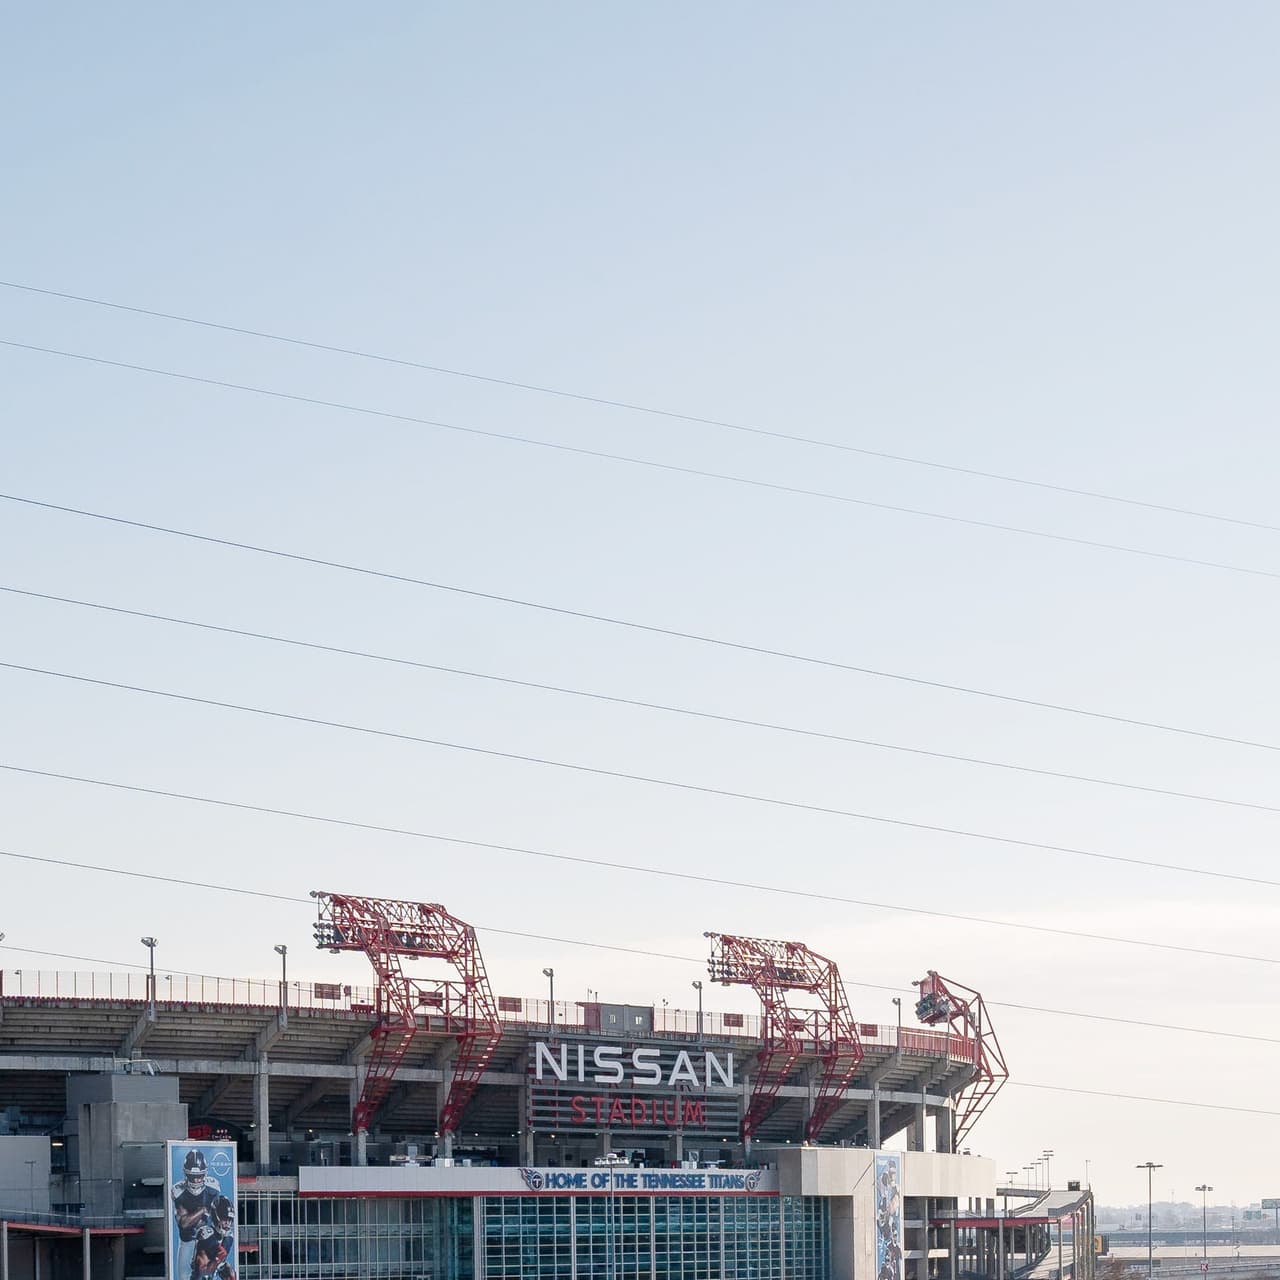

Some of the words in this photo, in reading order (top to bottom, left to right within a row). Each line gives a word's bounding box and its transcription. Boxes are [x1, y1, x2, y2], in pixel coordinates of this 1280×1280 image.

[535, 1042, 734, 1088] NISSAN
[571, 1095, 704, 1126] STADIUM
[545, 1173, 587, 1188] HOME
[591, 1173, 610, 1188] OF
[613, 1173, 638, 1188] THE
[640, 1174, 706, 1189] TENNESSEE
[707, 1174, 745, 1189] TITANS
